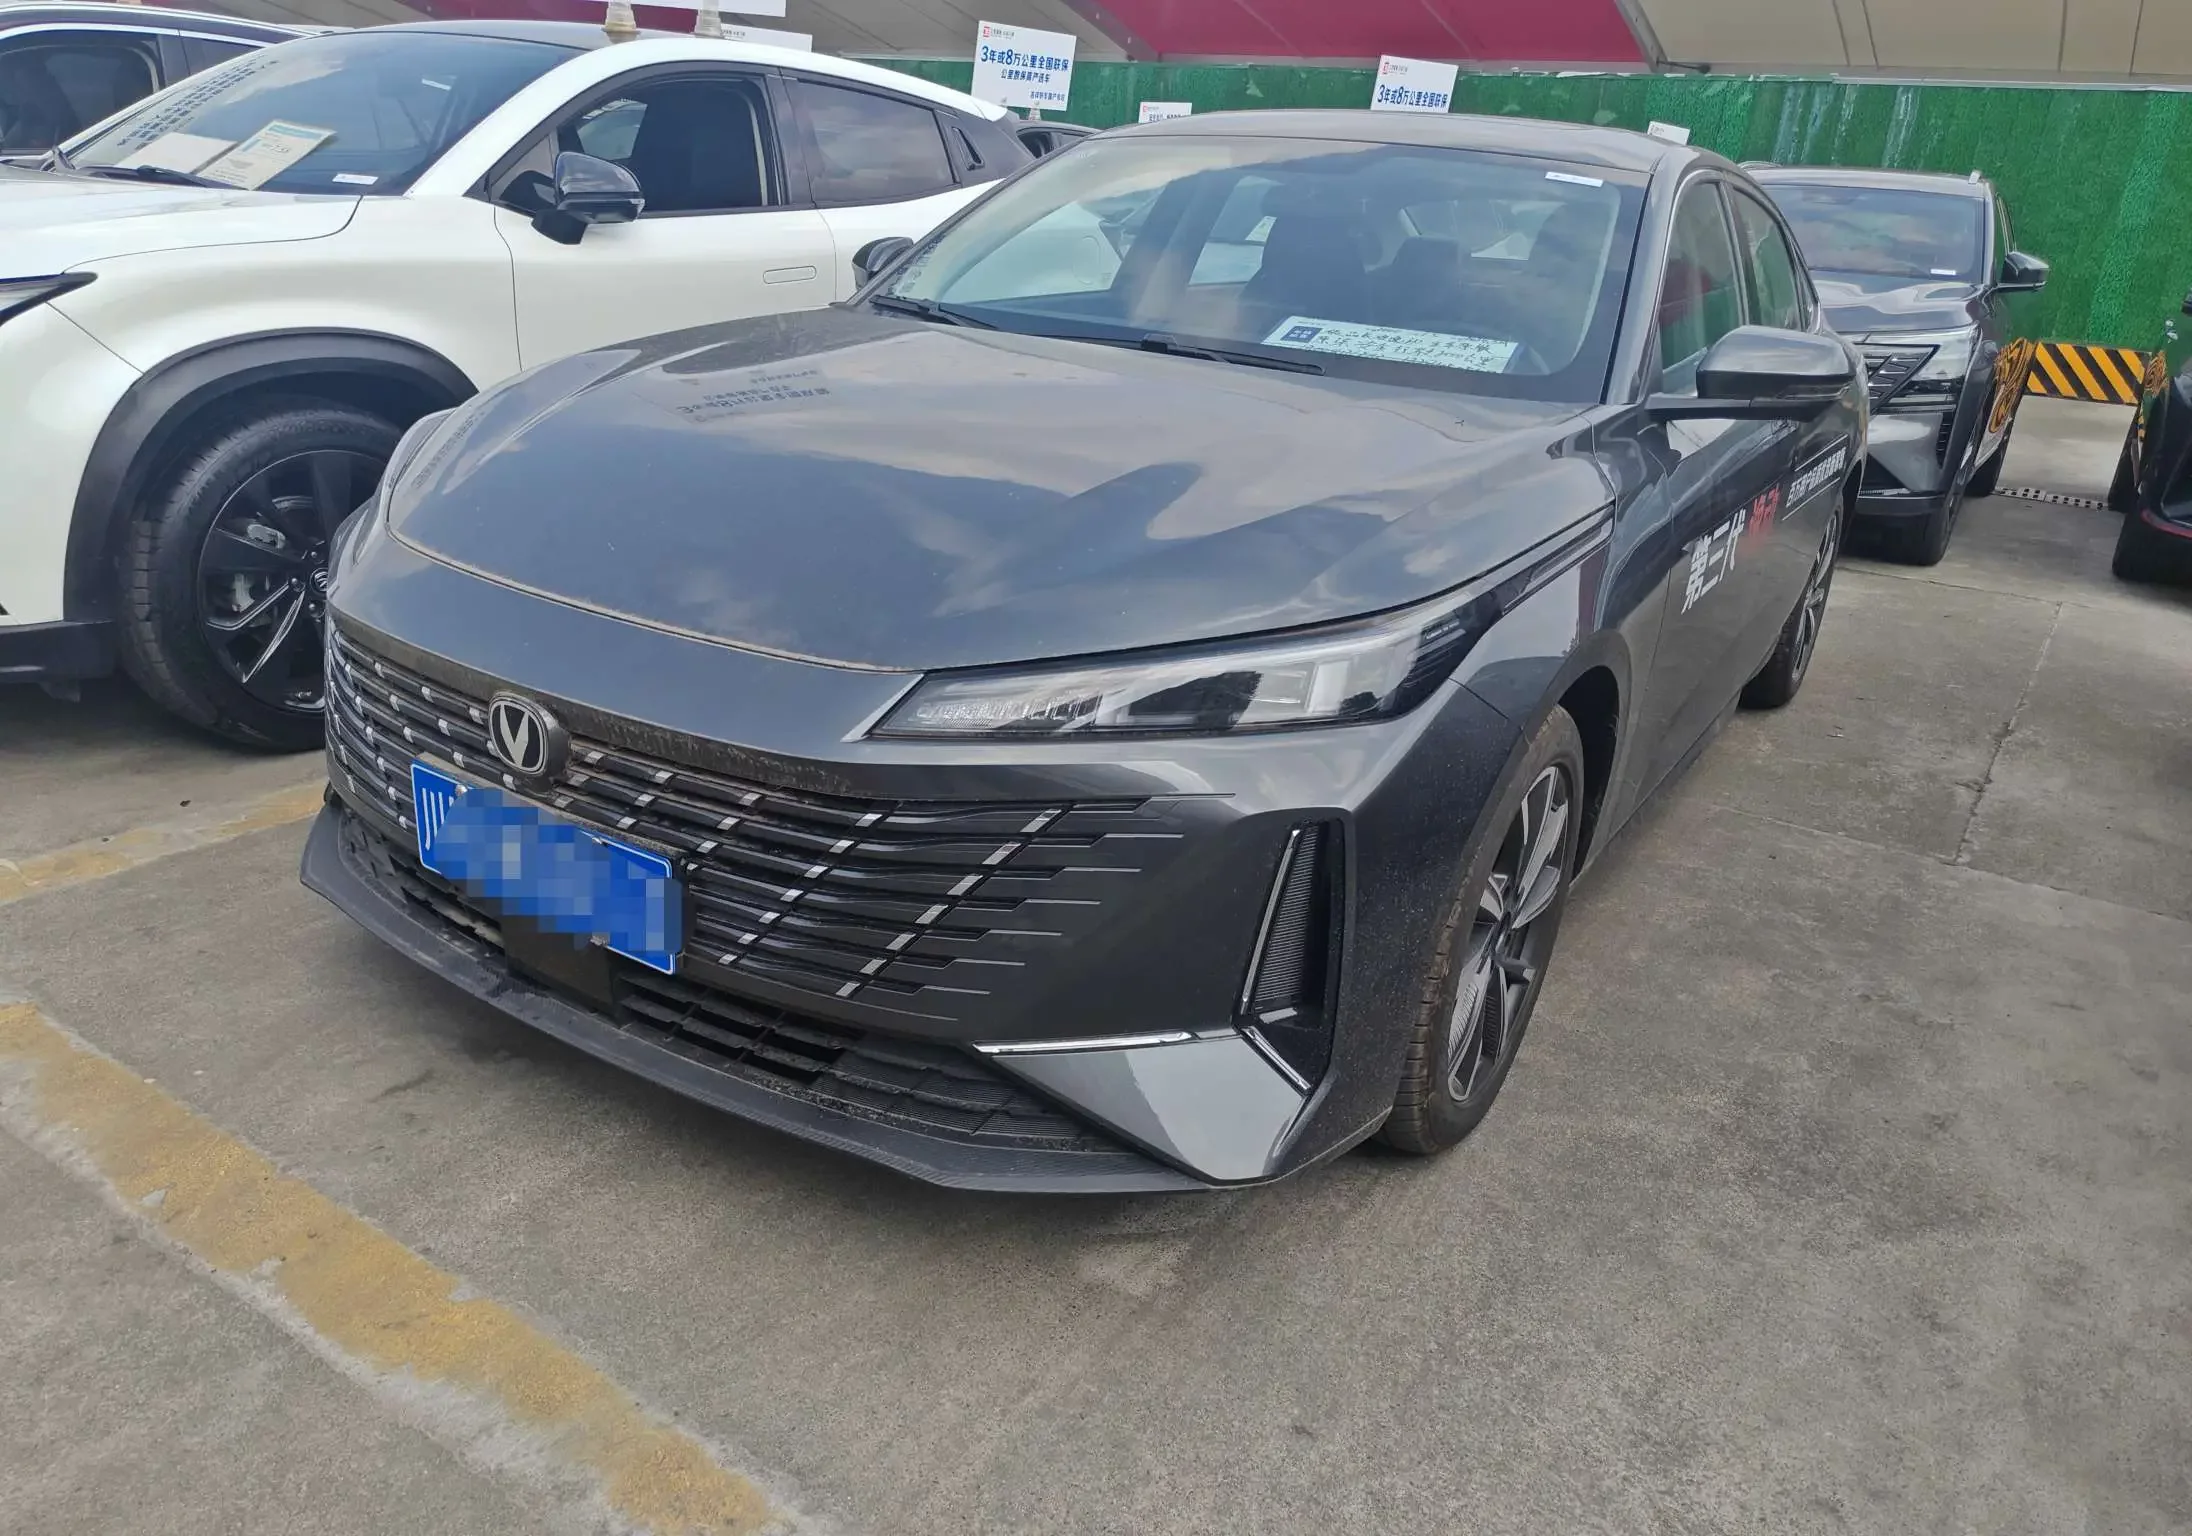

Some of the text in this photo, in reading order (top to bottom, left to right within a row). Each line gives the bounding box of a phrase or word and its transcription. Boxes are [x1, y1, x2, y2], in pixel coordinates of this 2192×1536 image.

[981, 45, 1069, 71] 3年或8万公里全国联保
[1377, 84, 1448, 108] 3年或8万公里全国联保
